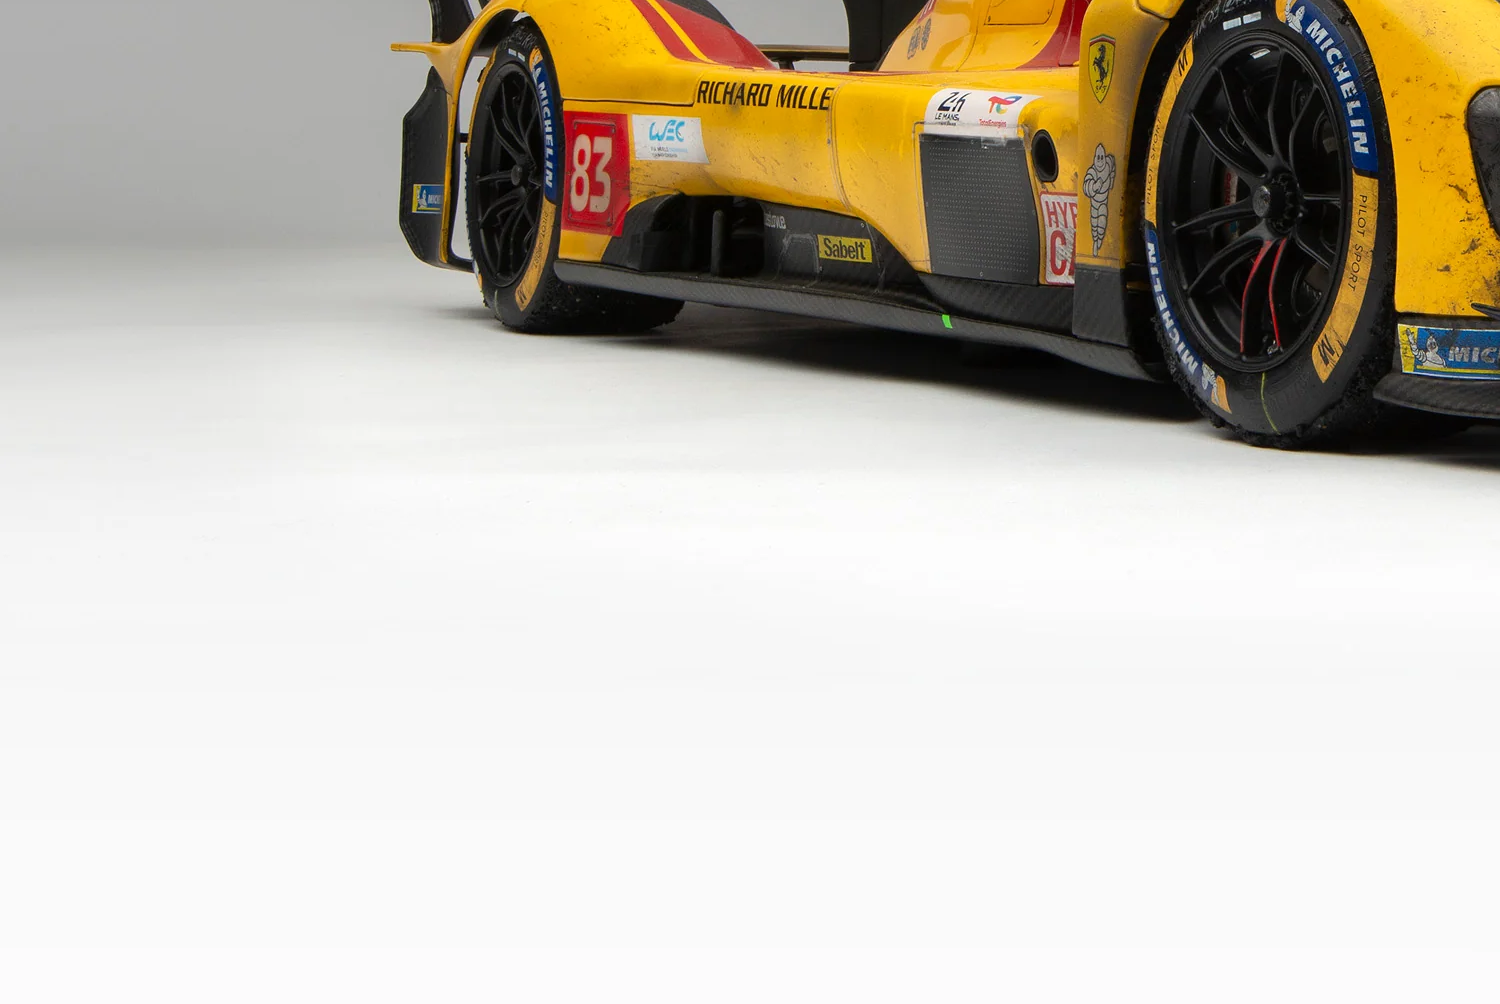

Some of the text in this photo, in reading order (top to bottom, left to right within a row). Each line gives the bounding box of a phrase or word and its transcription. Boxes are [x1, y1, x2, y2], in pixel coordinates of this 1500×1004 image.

[648, 118, 686, 143] WEC
[697, 80, 835, 111] RICHARD MILLE
[1305, 18, 1370, 155] MICHELIN
[538, 80, 554, 188] MICHELIN
[569, 133, 613, 213] 83
[823, 237, 867, 261] Sabelt
[1347, 194, 1368, 292] PILOT SPORT
[1147, 242, 1199, 375] MICHELIN
